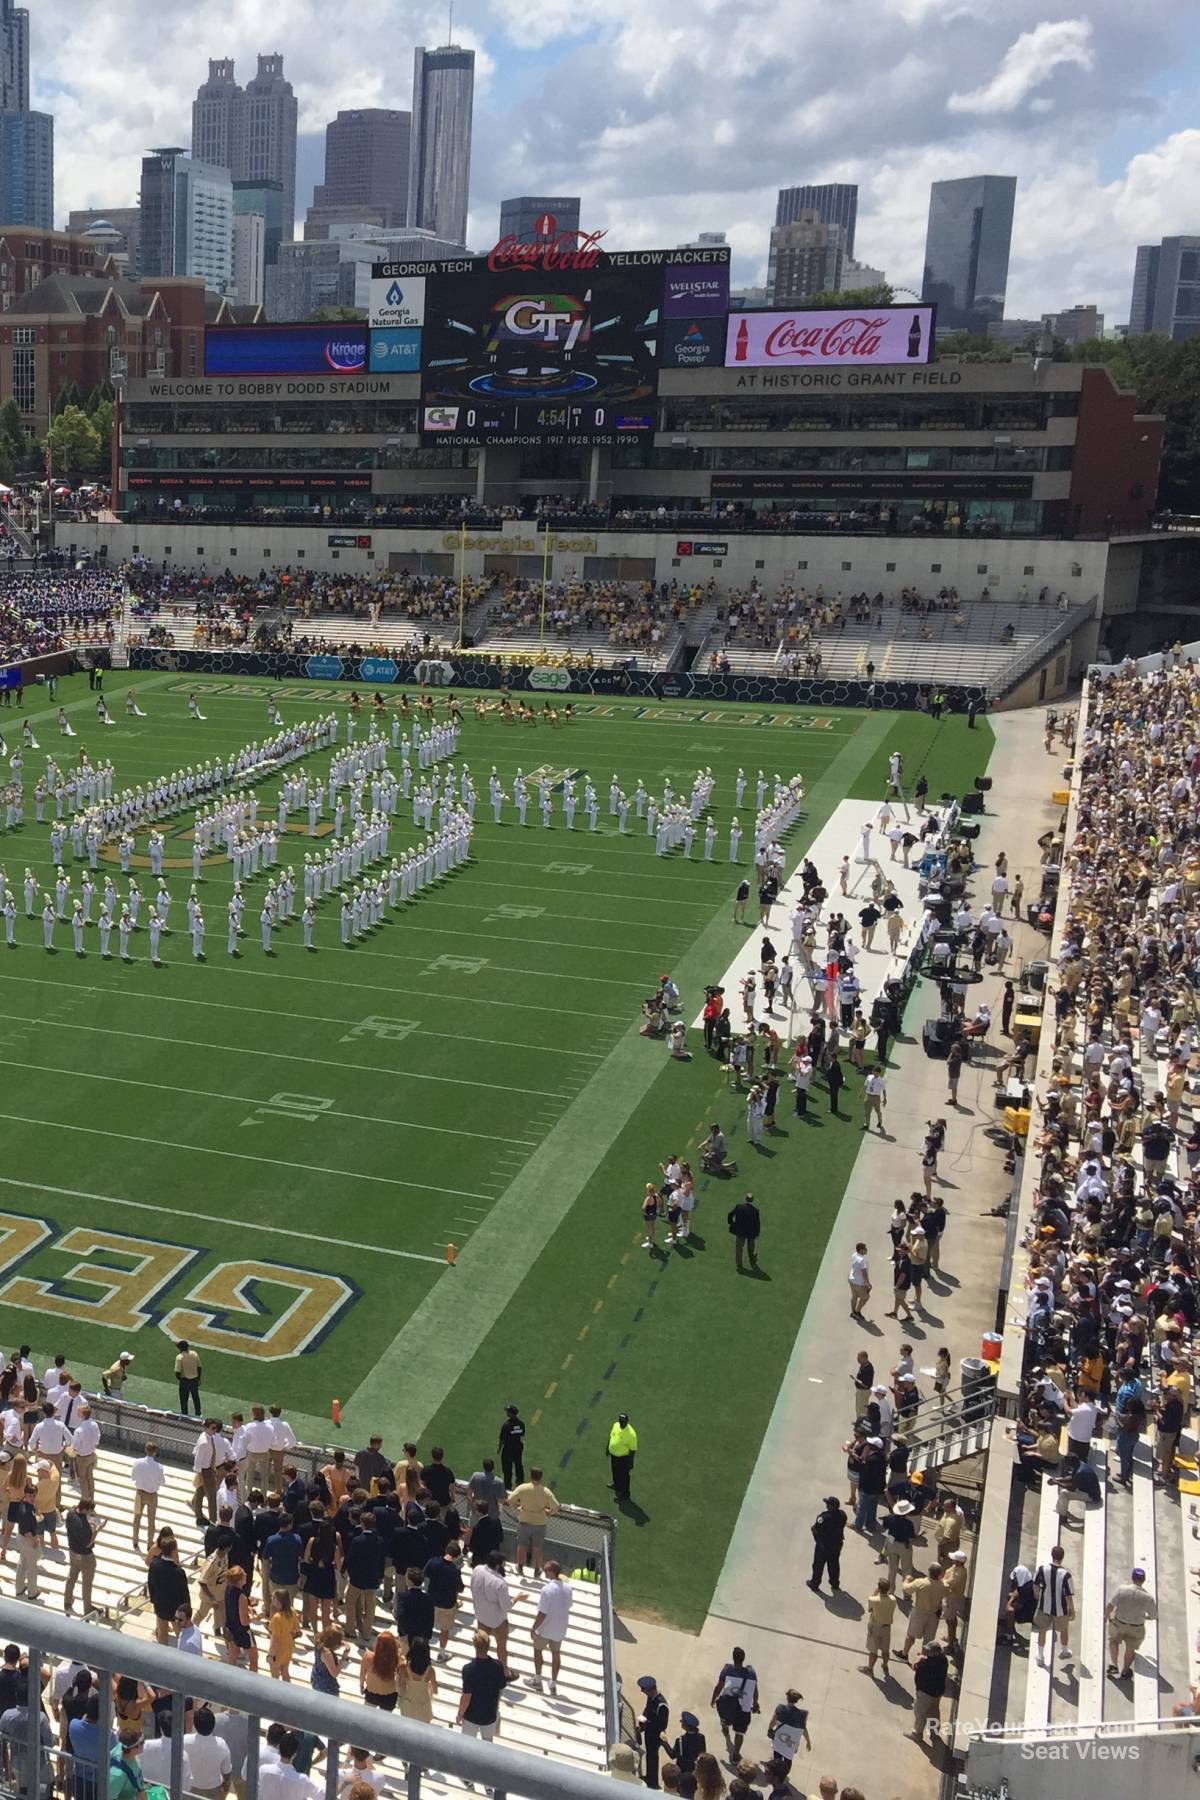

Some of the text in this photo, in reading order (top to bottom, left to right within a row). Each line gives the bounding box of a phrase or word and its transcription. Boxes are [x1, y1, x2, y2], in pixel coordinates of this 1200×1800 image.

[161, 160, 172, 170] W
[487, 229, 609, 273] Coca-Cola
[609, 250, 729, 266] YELLOW JACKETS
[382, 261, 473, 276] GEORGIA TECH
[670, 281, 720, 292] WELLSTAR
[378, 308, 411, 318] Georgia
[372, 316, 420, 327] Natural Gas
[765, 318, 892, 358] Coca-Cola
[390, 343, 418, 356] AT&T
[675, 344, 711, 355] Georgia
[678, 354, 707, 363] Power
[737, 371, 962, 387] AT HISTORIC GRANT FIELD
[150, 381, 391, 396] WELCOME TO BOBBY DODD STADIUM
[467, 410, 476, 427] 0
[537, 409, 566, 426] 4:54
[595, 408, 605, 426] 0
[436, 436, 481, 445] NATIONAL
[486, 436, 542, 445] CHAMPIONS
[616, 436, 639, 445] 1990
[441, 535, 598, 553] Georgia Tech
[375, 667, 394, 675] AT&T
[532, 672, 568, 686] sage
